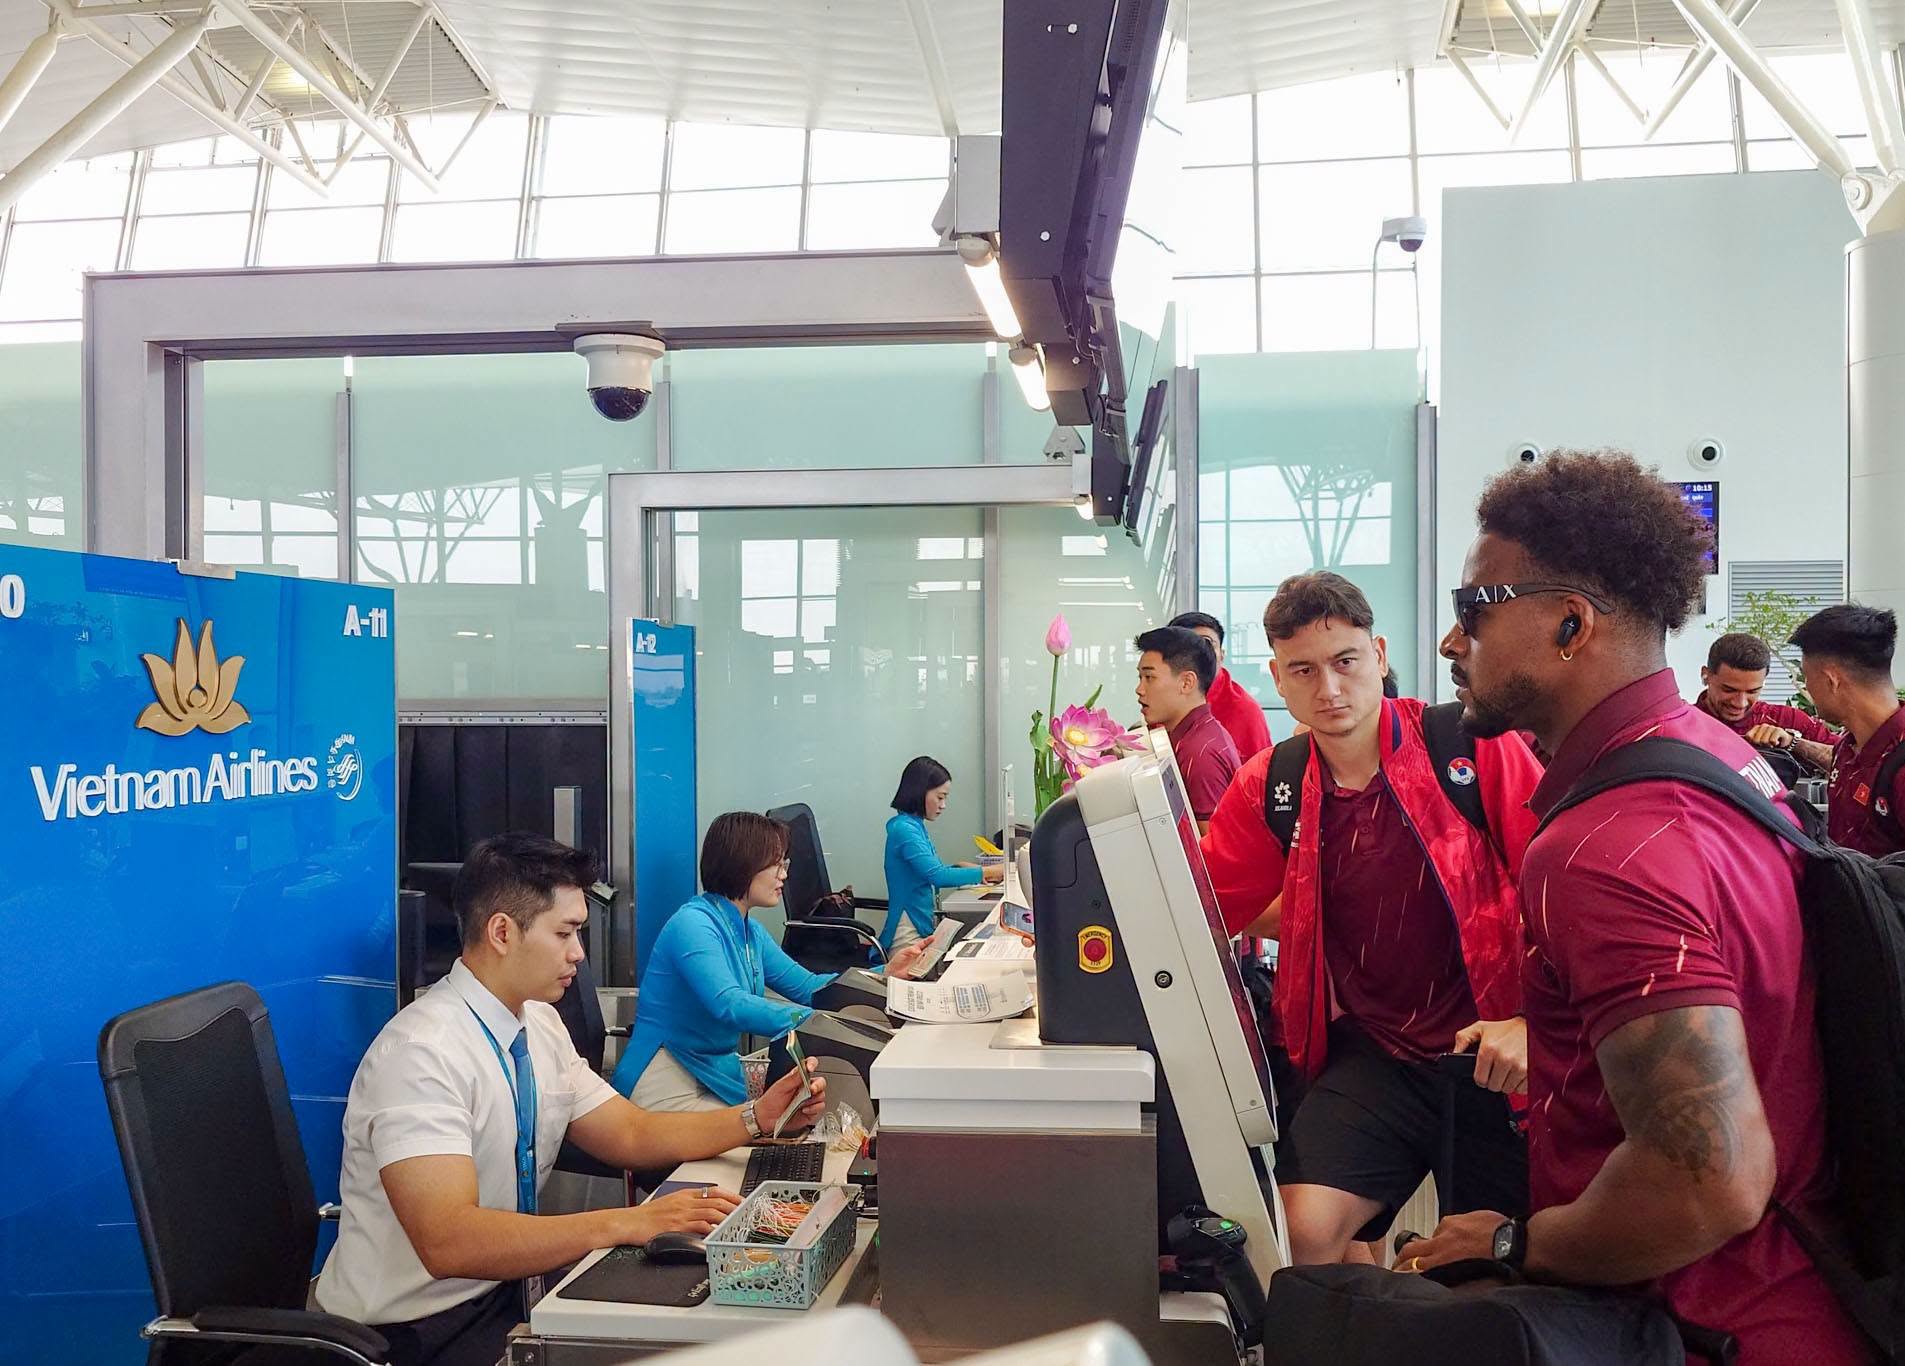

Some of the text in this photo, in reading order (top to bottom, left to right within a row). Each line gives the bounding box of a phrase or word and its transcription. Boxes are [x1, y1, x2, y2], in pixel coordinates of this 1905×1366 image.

[0, 574, 25, 618] 0
[343, 605, 387, 638] A-11
[30, 748, 318, 821] Vietnam Airlines
